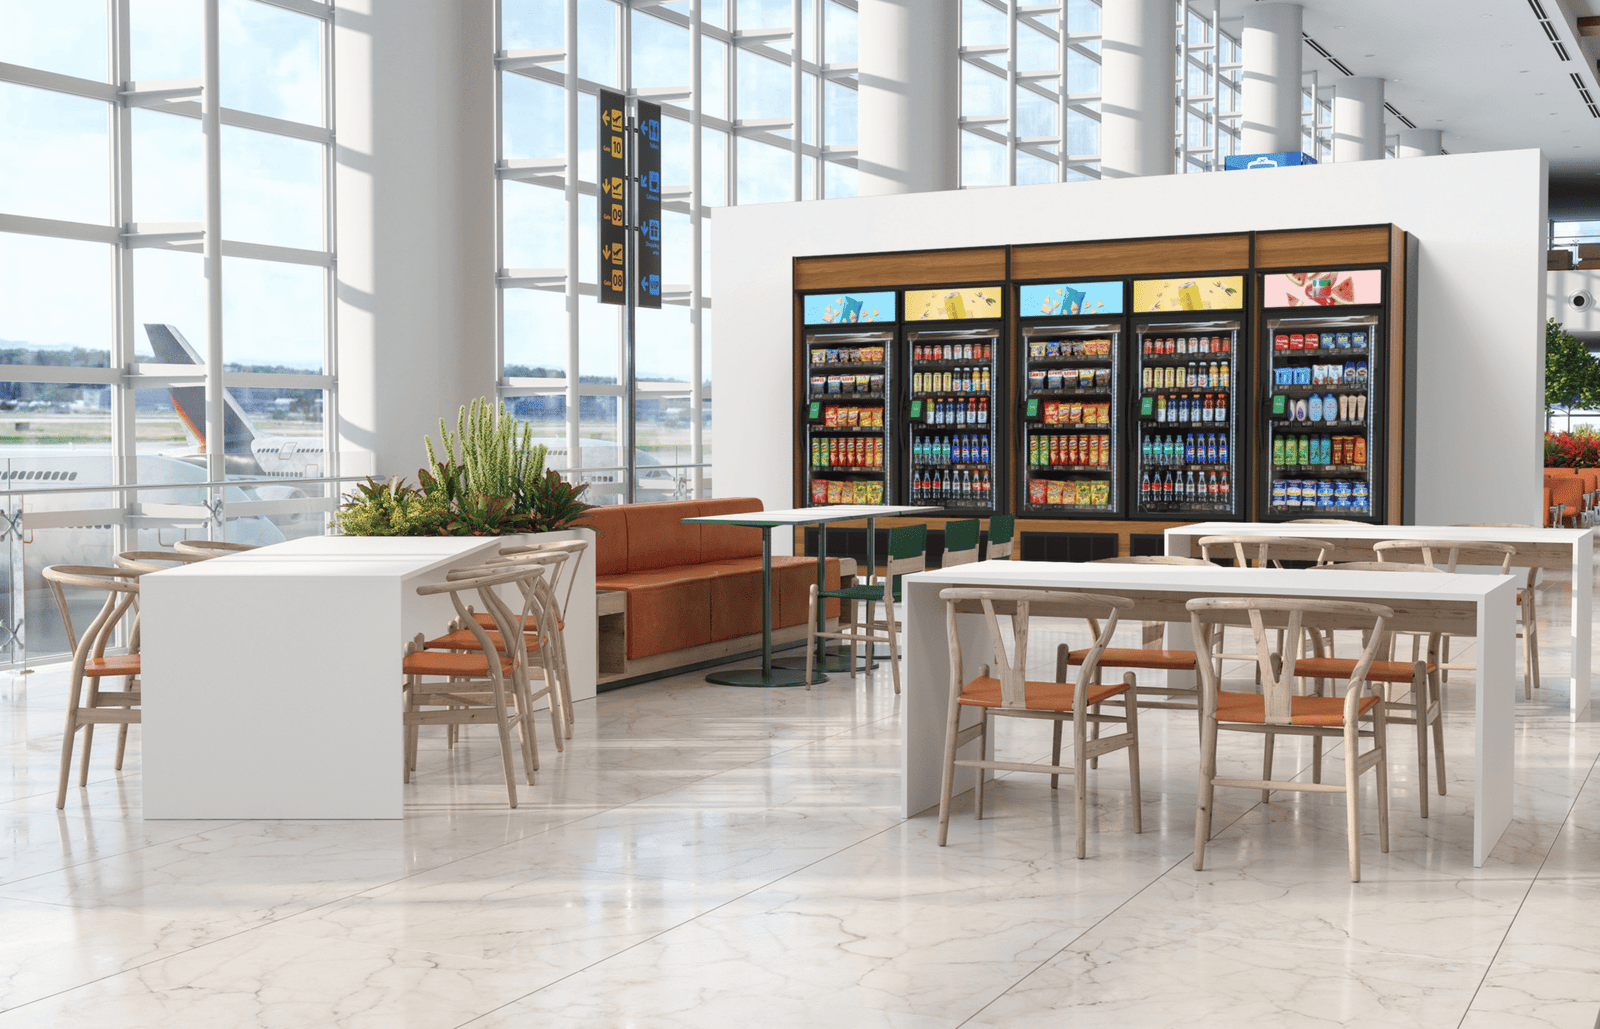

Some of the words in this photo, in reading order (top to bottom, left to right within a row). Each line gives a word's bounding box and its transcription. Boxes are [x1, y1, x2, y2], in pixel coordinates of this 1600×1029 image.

[613, 141, 621, 154] 10
[613, 208, 622, 221] 09
[613, 274, 622, 286] 08
